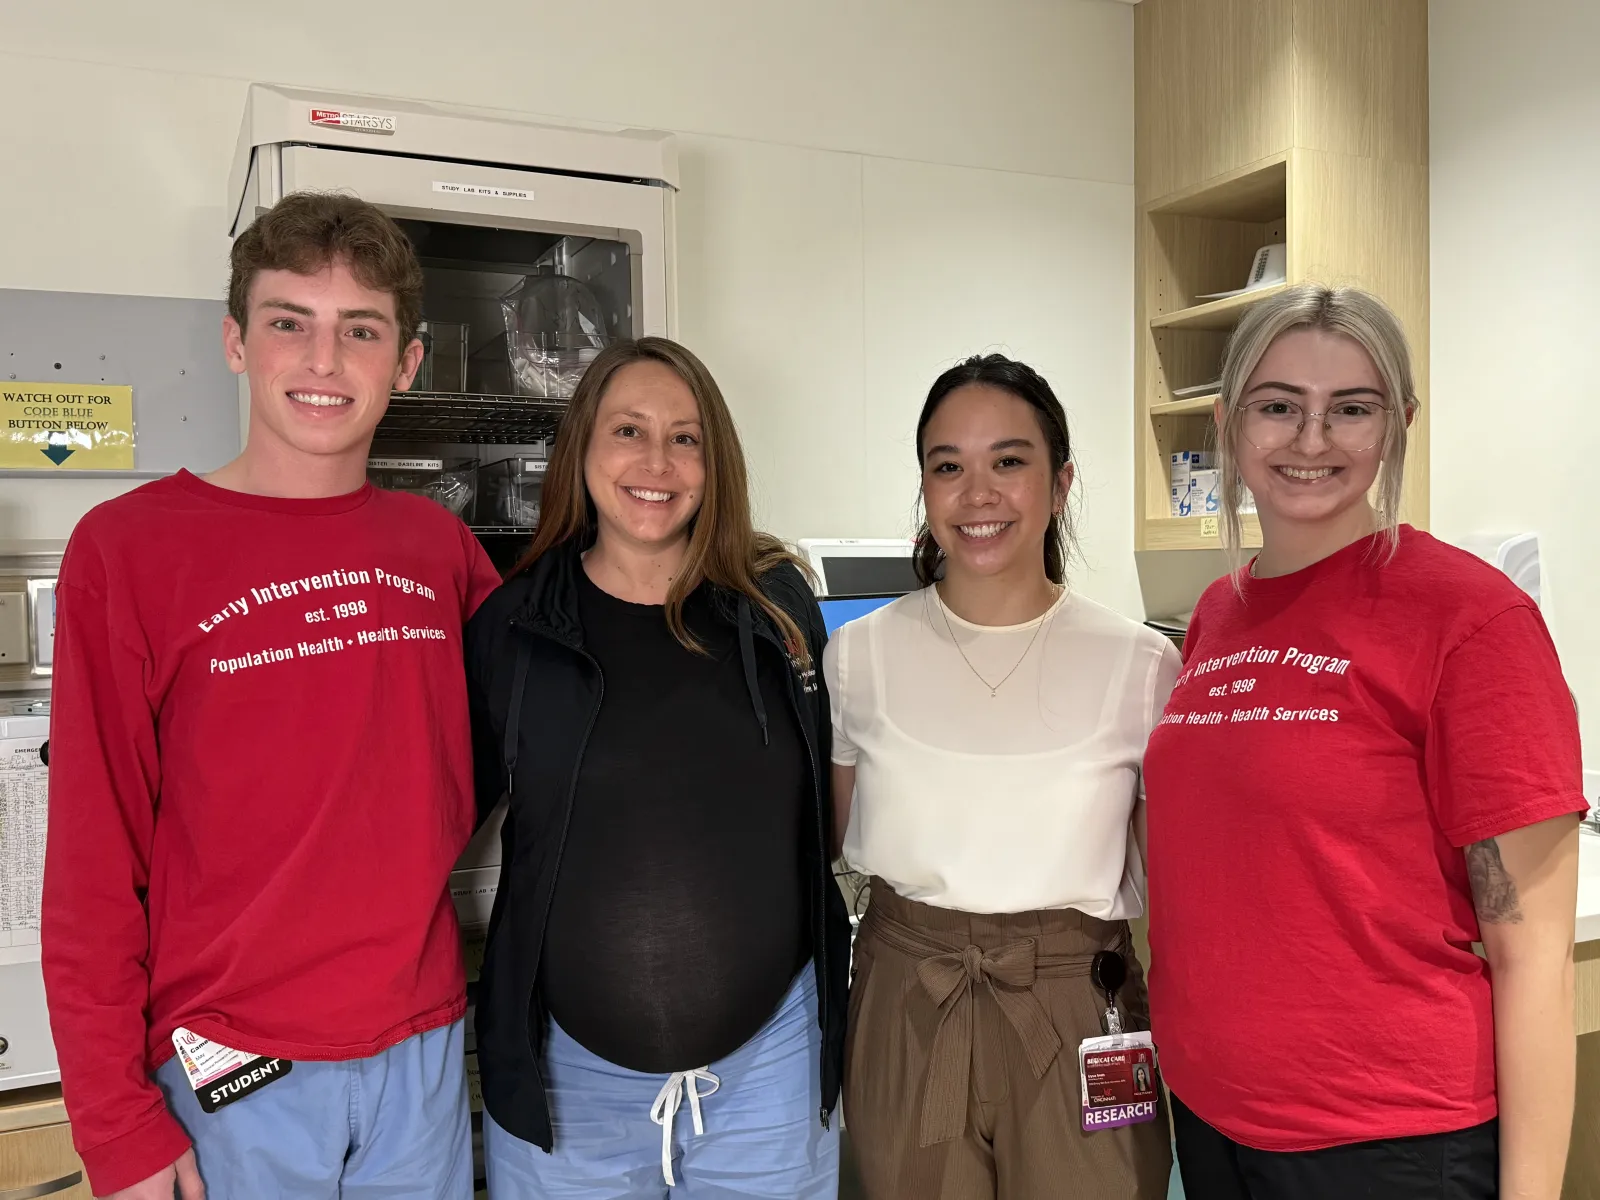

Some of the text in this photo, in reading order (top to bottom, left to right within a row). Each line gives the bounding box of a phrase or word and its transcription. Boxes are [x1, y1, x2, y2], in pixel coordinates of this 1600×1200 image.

[341, 113, 393, 130] STARSYS
[2, 392, 112, 405] WATCH OUT FOR
[23, 406, 94, 418] CODE BLUE
[8, 419, 109, 431] BUTTON BELOW
[197, 567, 436, 633] Early Intervention Program
[304, 600, 368, 624] est. 1998
[209, 625, 447, 674] Population Health Health Services
[1193, 645, 1280, 677] Intervention
[1281, 646, 1351, 675] Program
[1208, 678, 1257, 697] est. 1998
[1185, 711, 1224, 725] Health
[1230, 706, 1270, 723] Health
[1272, 706, 1339, 722] Services
[210, 1058, 280, 1104] STUDENT
[1085, 1101, 1153, 1125] RESEARCH
